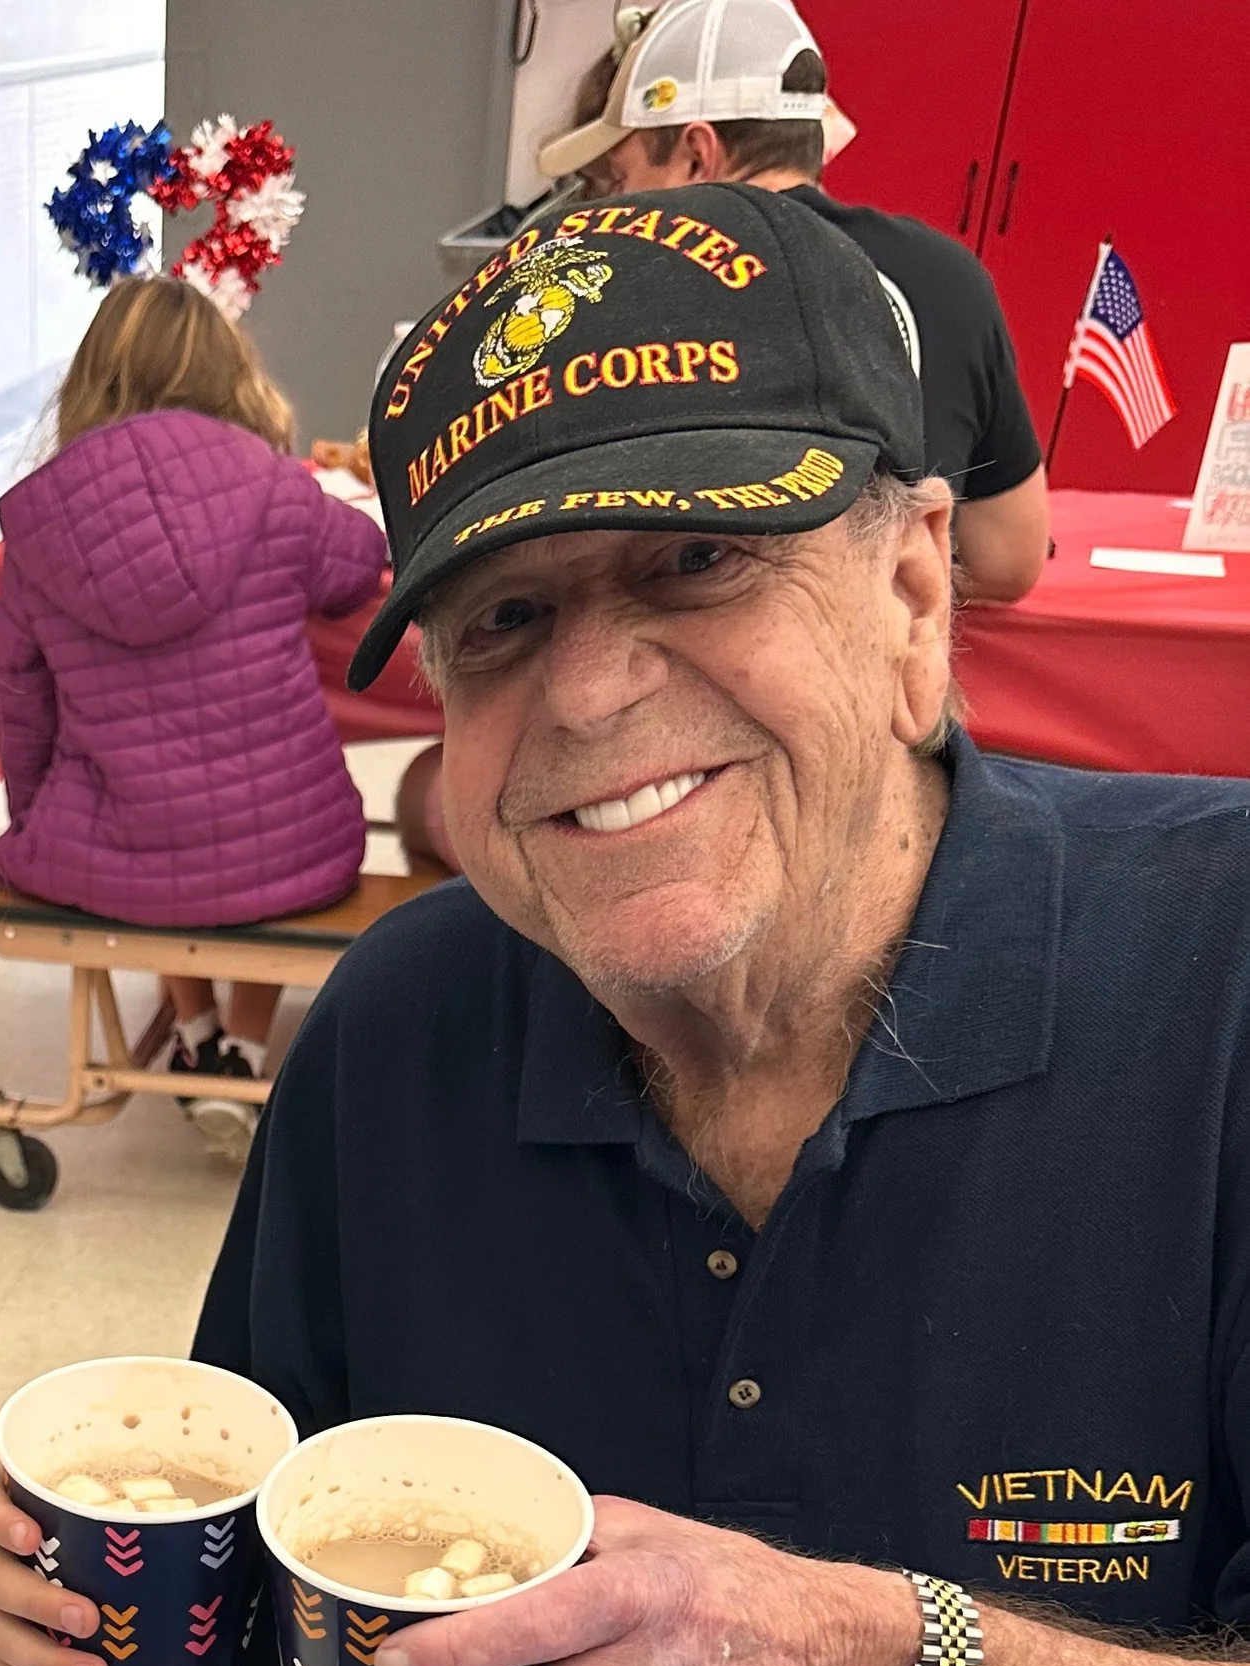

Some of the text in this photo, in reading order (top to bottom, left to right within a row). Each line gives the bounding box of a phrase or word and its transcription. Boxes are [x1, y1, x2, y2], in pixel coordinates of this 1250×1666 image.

[385, 206, 768, 421] UNITED STATES
[406, 341, 741, 508] MARINE CORPS
[453, 447, 845, 547] THE FEW, THE PROUD
[955, 1468, 1194, 1512] VIETNAM
[996, 1554, 1150, 1584] VETERAN
